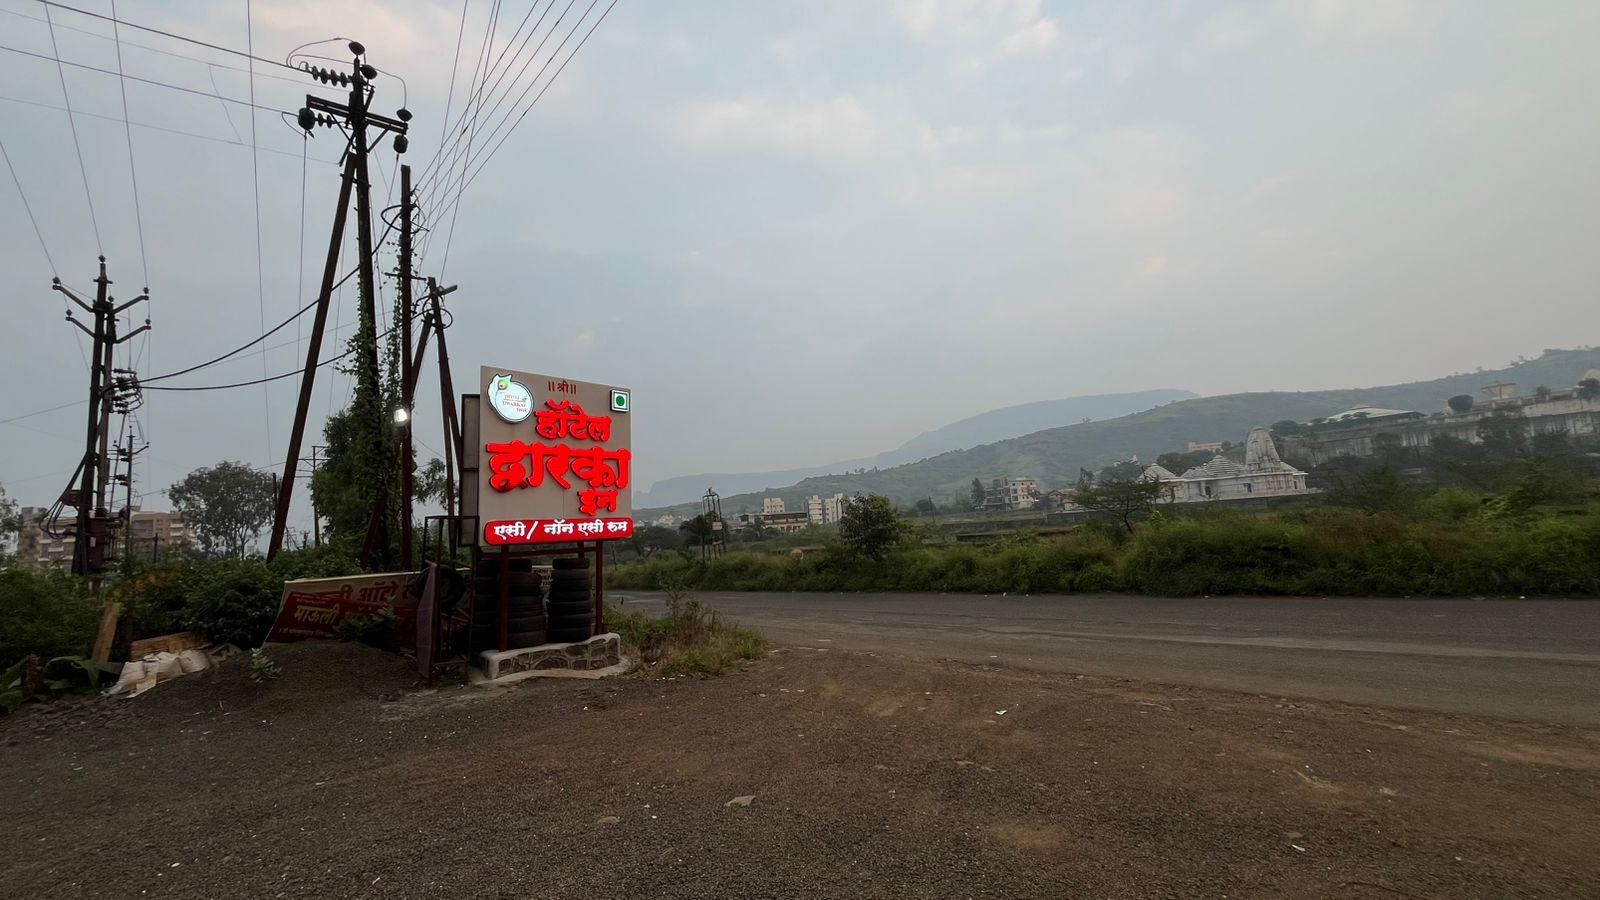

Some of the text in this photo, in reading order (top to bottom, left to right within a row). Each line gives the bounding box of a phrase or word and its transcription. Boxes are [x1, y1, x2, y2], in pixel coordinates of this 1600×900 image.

[534, 399, 612, 442] हॉटेल
[486, 440, 631, 491] द्वारका
[577, 488, 619, 517] इन
[544, 519, 574, 534] नॉन
[577, 519, 604, 536] एसी
